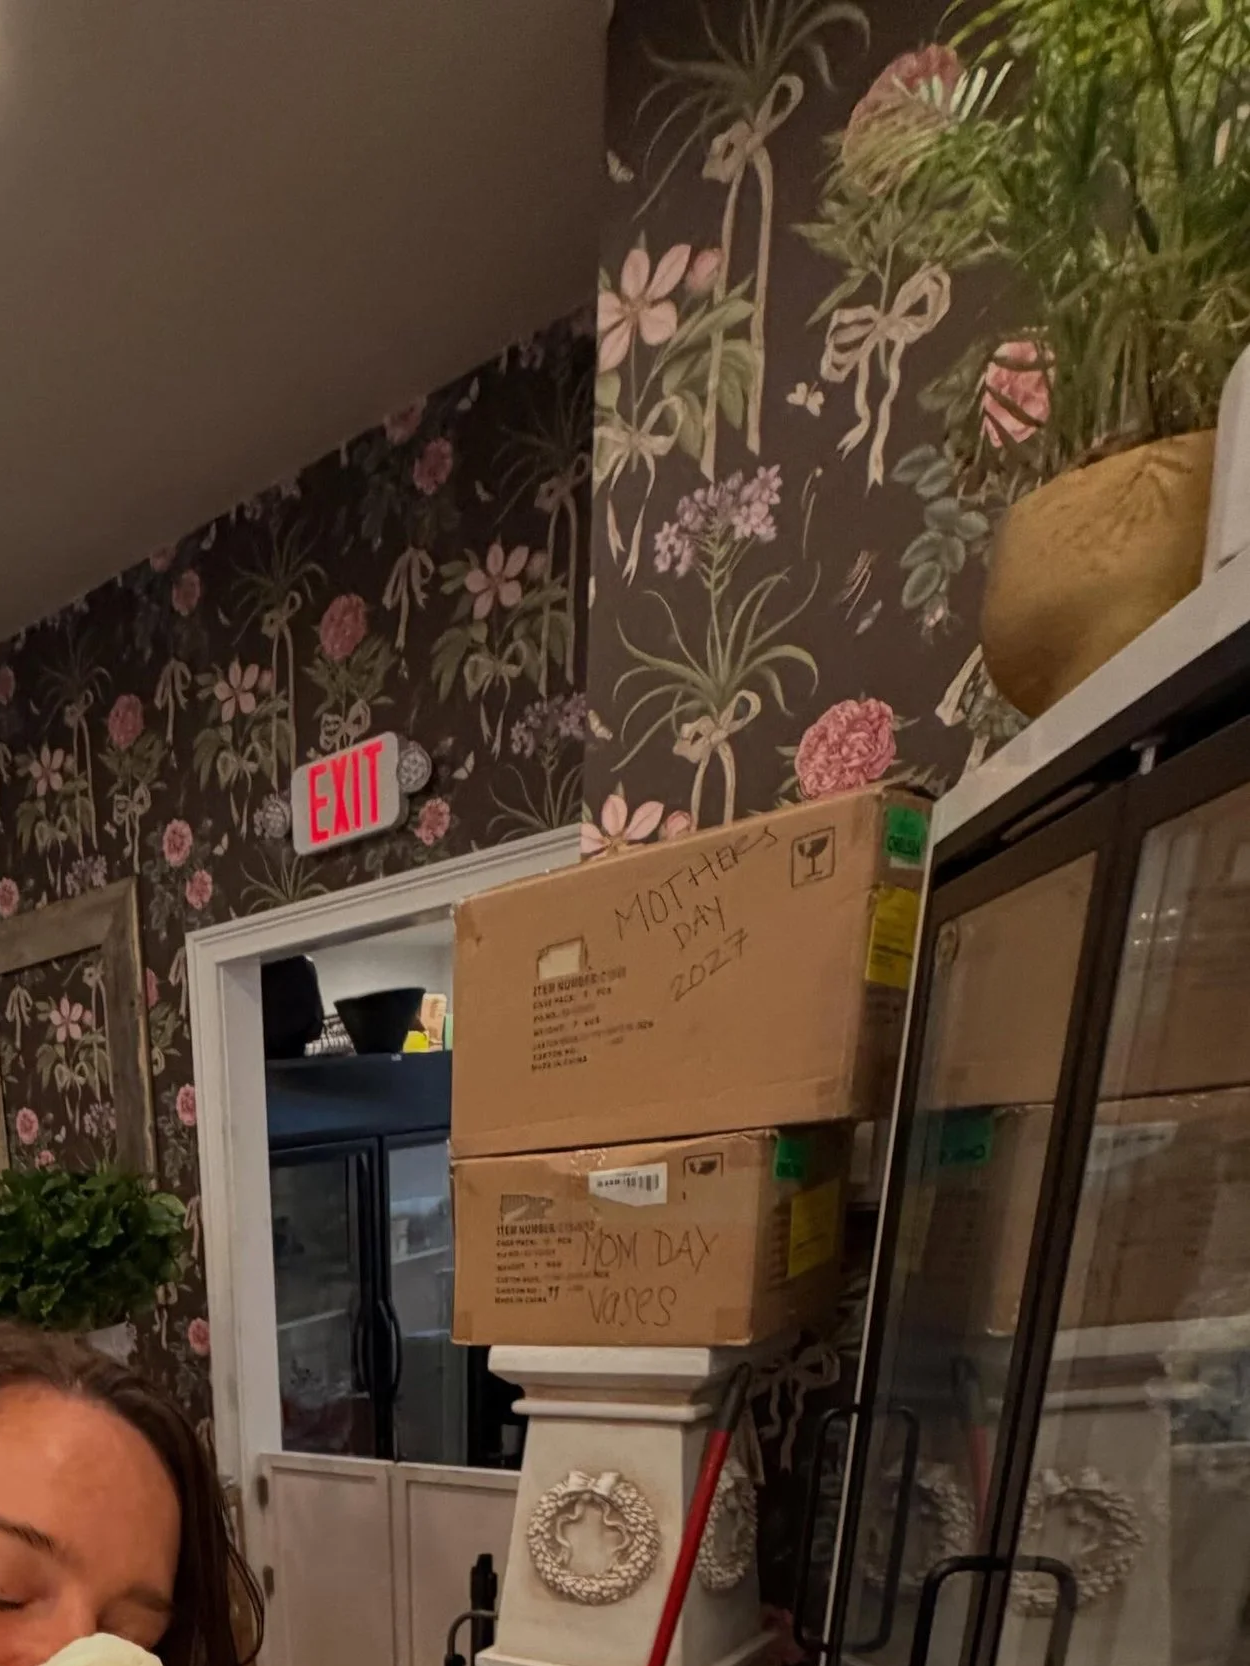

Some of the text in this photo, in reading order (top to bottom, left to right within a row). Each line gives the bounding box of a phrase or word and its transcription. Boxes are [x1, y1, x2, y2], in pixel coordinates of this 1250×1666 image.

[309, 739, 384, 844] EXIT
[673, 895, 726, 951] DAY
[670, 927, 748, 1002] 2027
[581, 1224, 719, 1274] MOM DAY
